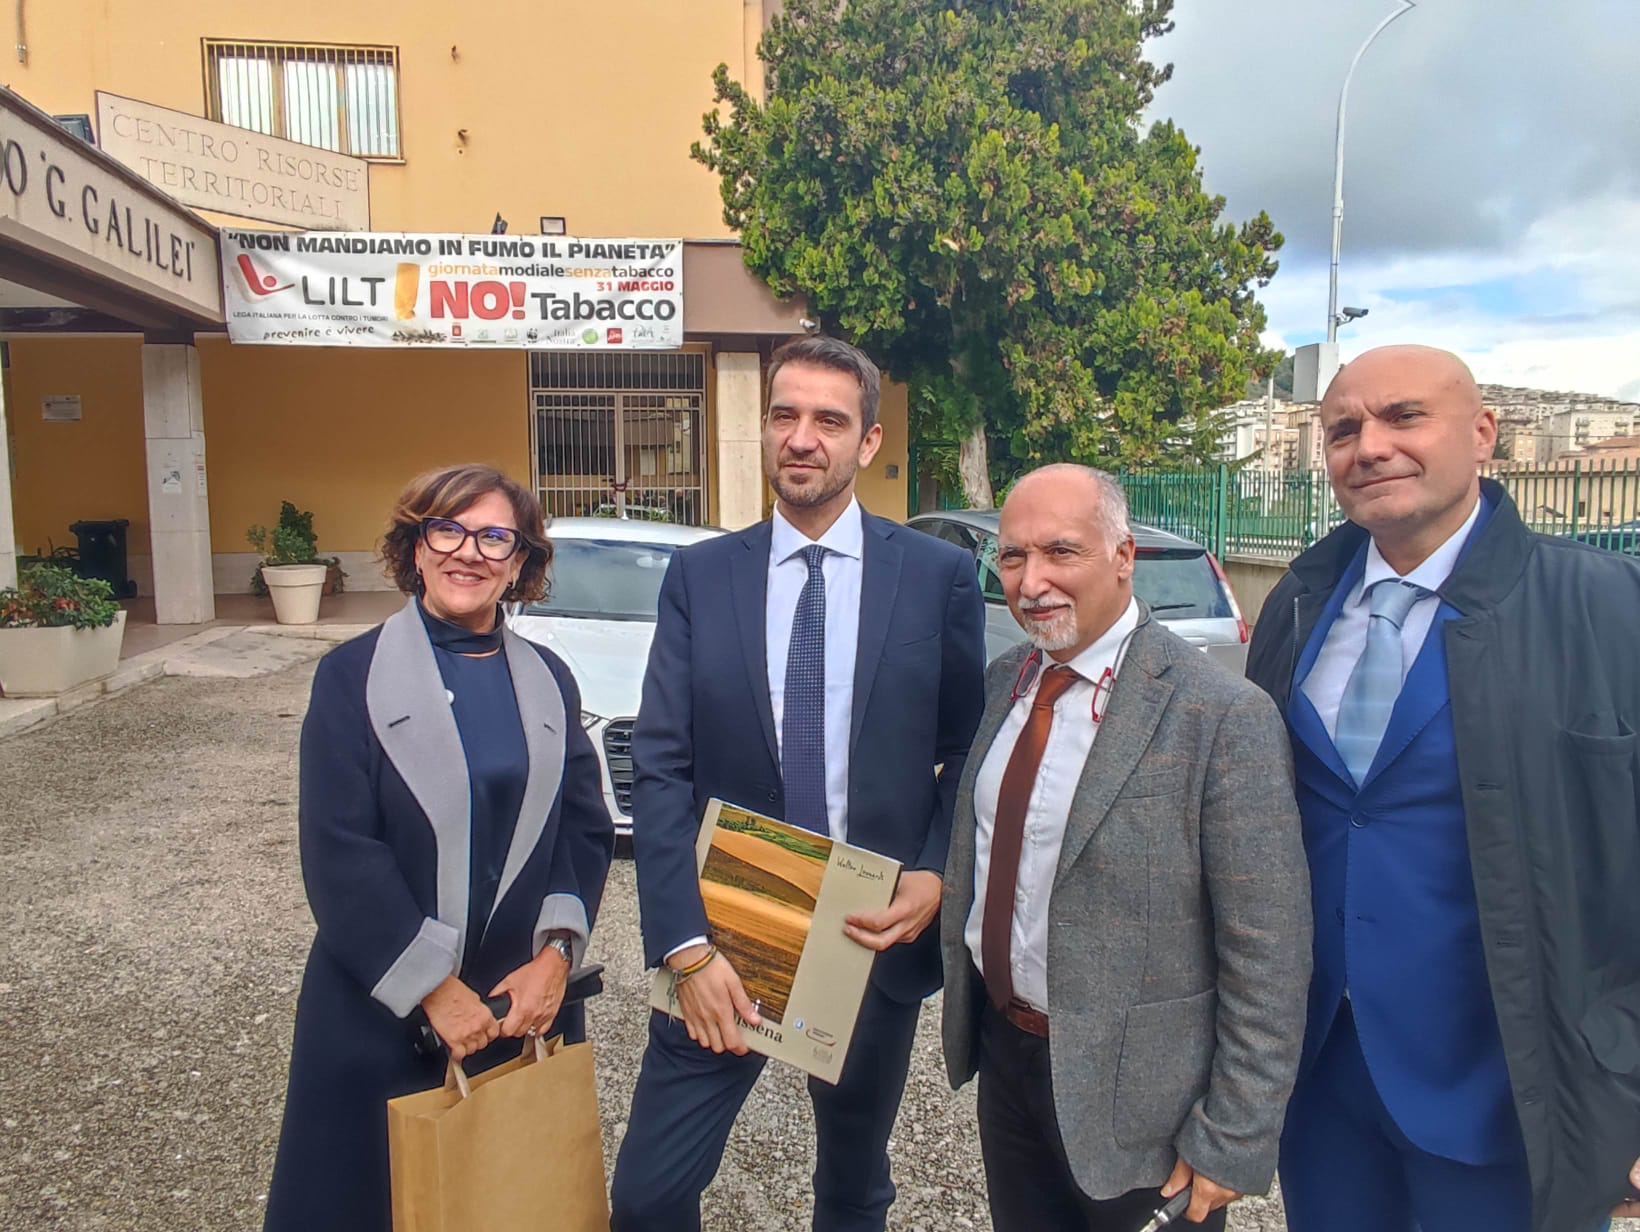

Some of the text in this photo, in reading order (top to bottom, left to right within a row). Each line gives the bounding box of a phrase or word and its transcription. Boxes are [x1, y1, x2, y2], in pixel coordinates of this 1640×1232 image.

[112, 113, 359, 192] CENTRO RISORSE
[139, 156, 342, 220] TERRITORIALI
[297, 237, 431, 256] MANDIAMO
[438, 239, 463, 256] IN
[469, 239, 536, 259] FUMO
[541, 242, 562, 259] IL
[302, 275, 386, 307] LILT
[429, 281, 676, 321] NO! Tabacco
[597, 281, 674, 292] 31 MAGGIO
[263, 328, 321, 340] prevenire
[337, 325, 375, 335] vivere
